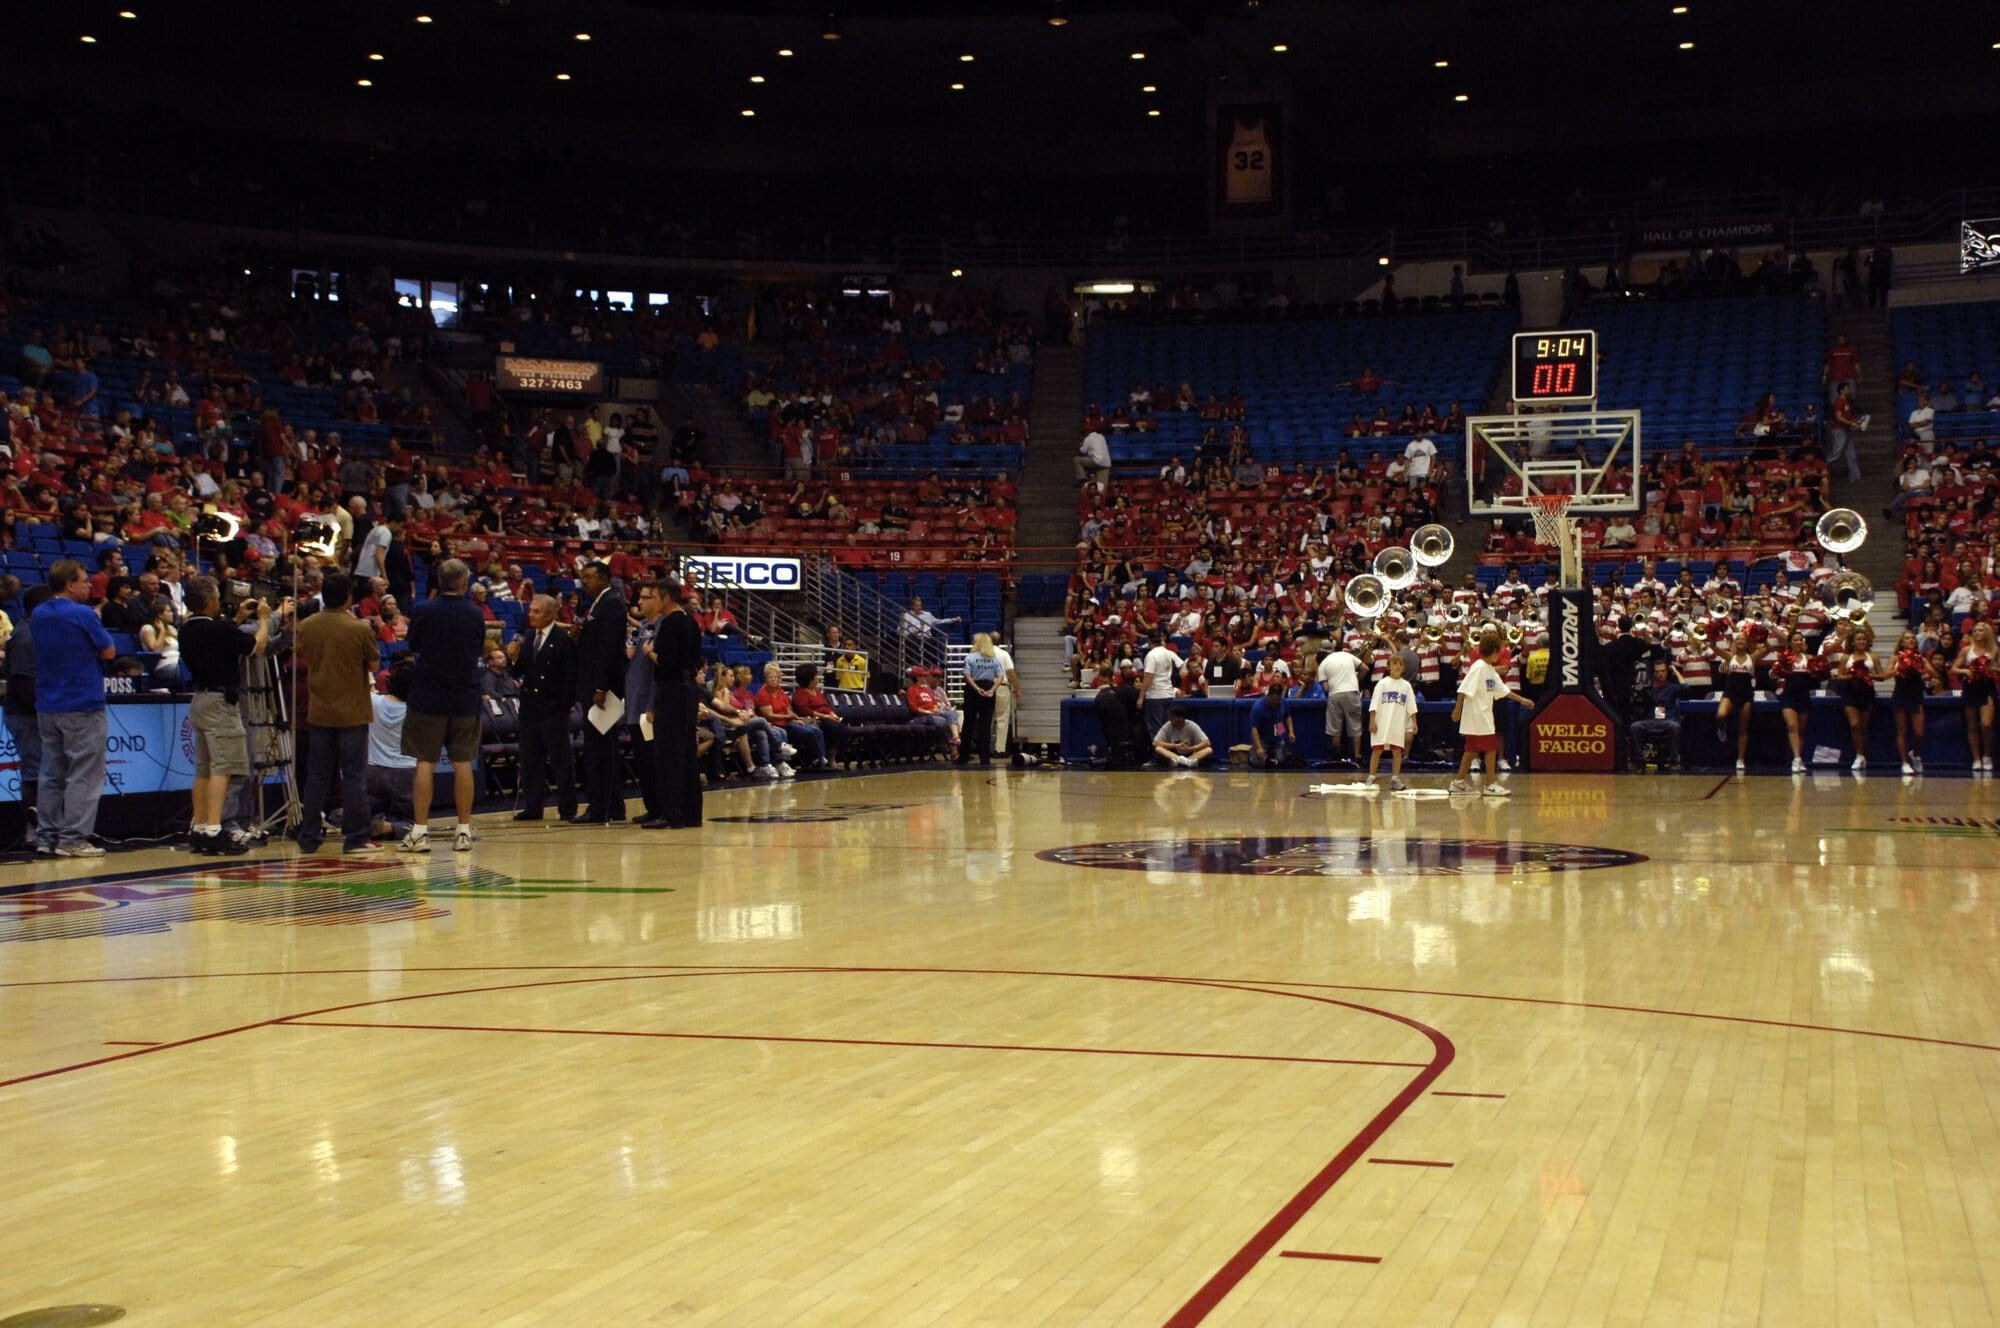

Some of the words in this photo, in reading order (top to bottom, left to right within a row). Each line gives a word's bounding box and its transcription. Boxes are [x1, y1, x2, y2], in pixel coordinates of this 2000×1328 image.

[1235, 151, 1264, 170] 32
[1643, 231, 1673, 241] HALL
[1679, 229, 1693, 239] OF
[1698, 223, 1774, 238] CHAMPIONS
[1537, 338, 1585, 358] 9:04
[520, 377, 583, 390] 327-7463
[1533, 363, 1576, 394] 00
[840, 472, 850, 481] 19
[1267, 467, 1279, 476] 20
[889, 551, 900, 561] 19
[684, 562, 798, 585] GEICO
[1562, 597, 1579, 688] ARIZONA
[104, 677, 137, 694] POSS.
[1536, 723, 1607, 738] WELLS
[1539, 740, 1606, 754] FARGO
